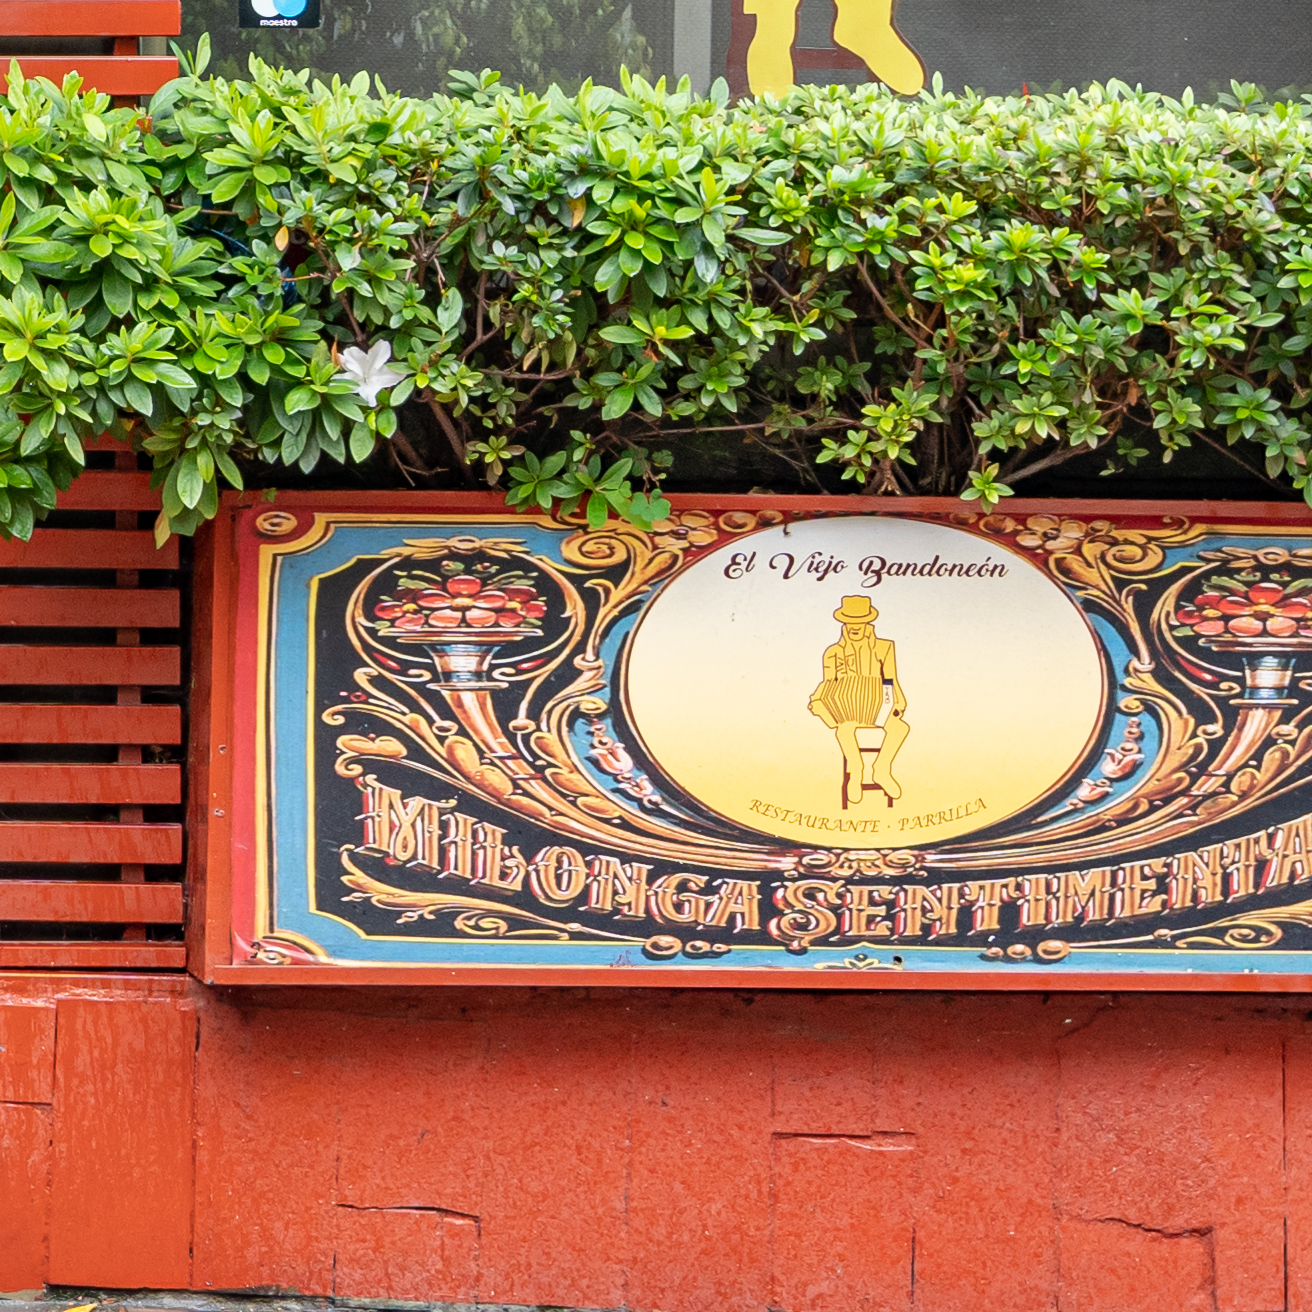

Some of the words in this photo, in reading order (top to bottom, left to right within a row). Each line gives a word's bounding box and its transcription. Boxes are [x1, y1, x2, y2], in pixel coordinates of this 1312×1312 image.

[723, 551, 757, 580] El
[769, 551, 848, 582] Viejo
[858, 555, 1009, 589] Bandoneón
[748, 798, 881, 833] RESTAURANTE
[899, 797, 988, 831] PARRILLA
[356, 775, 762, 934] MILONGA
